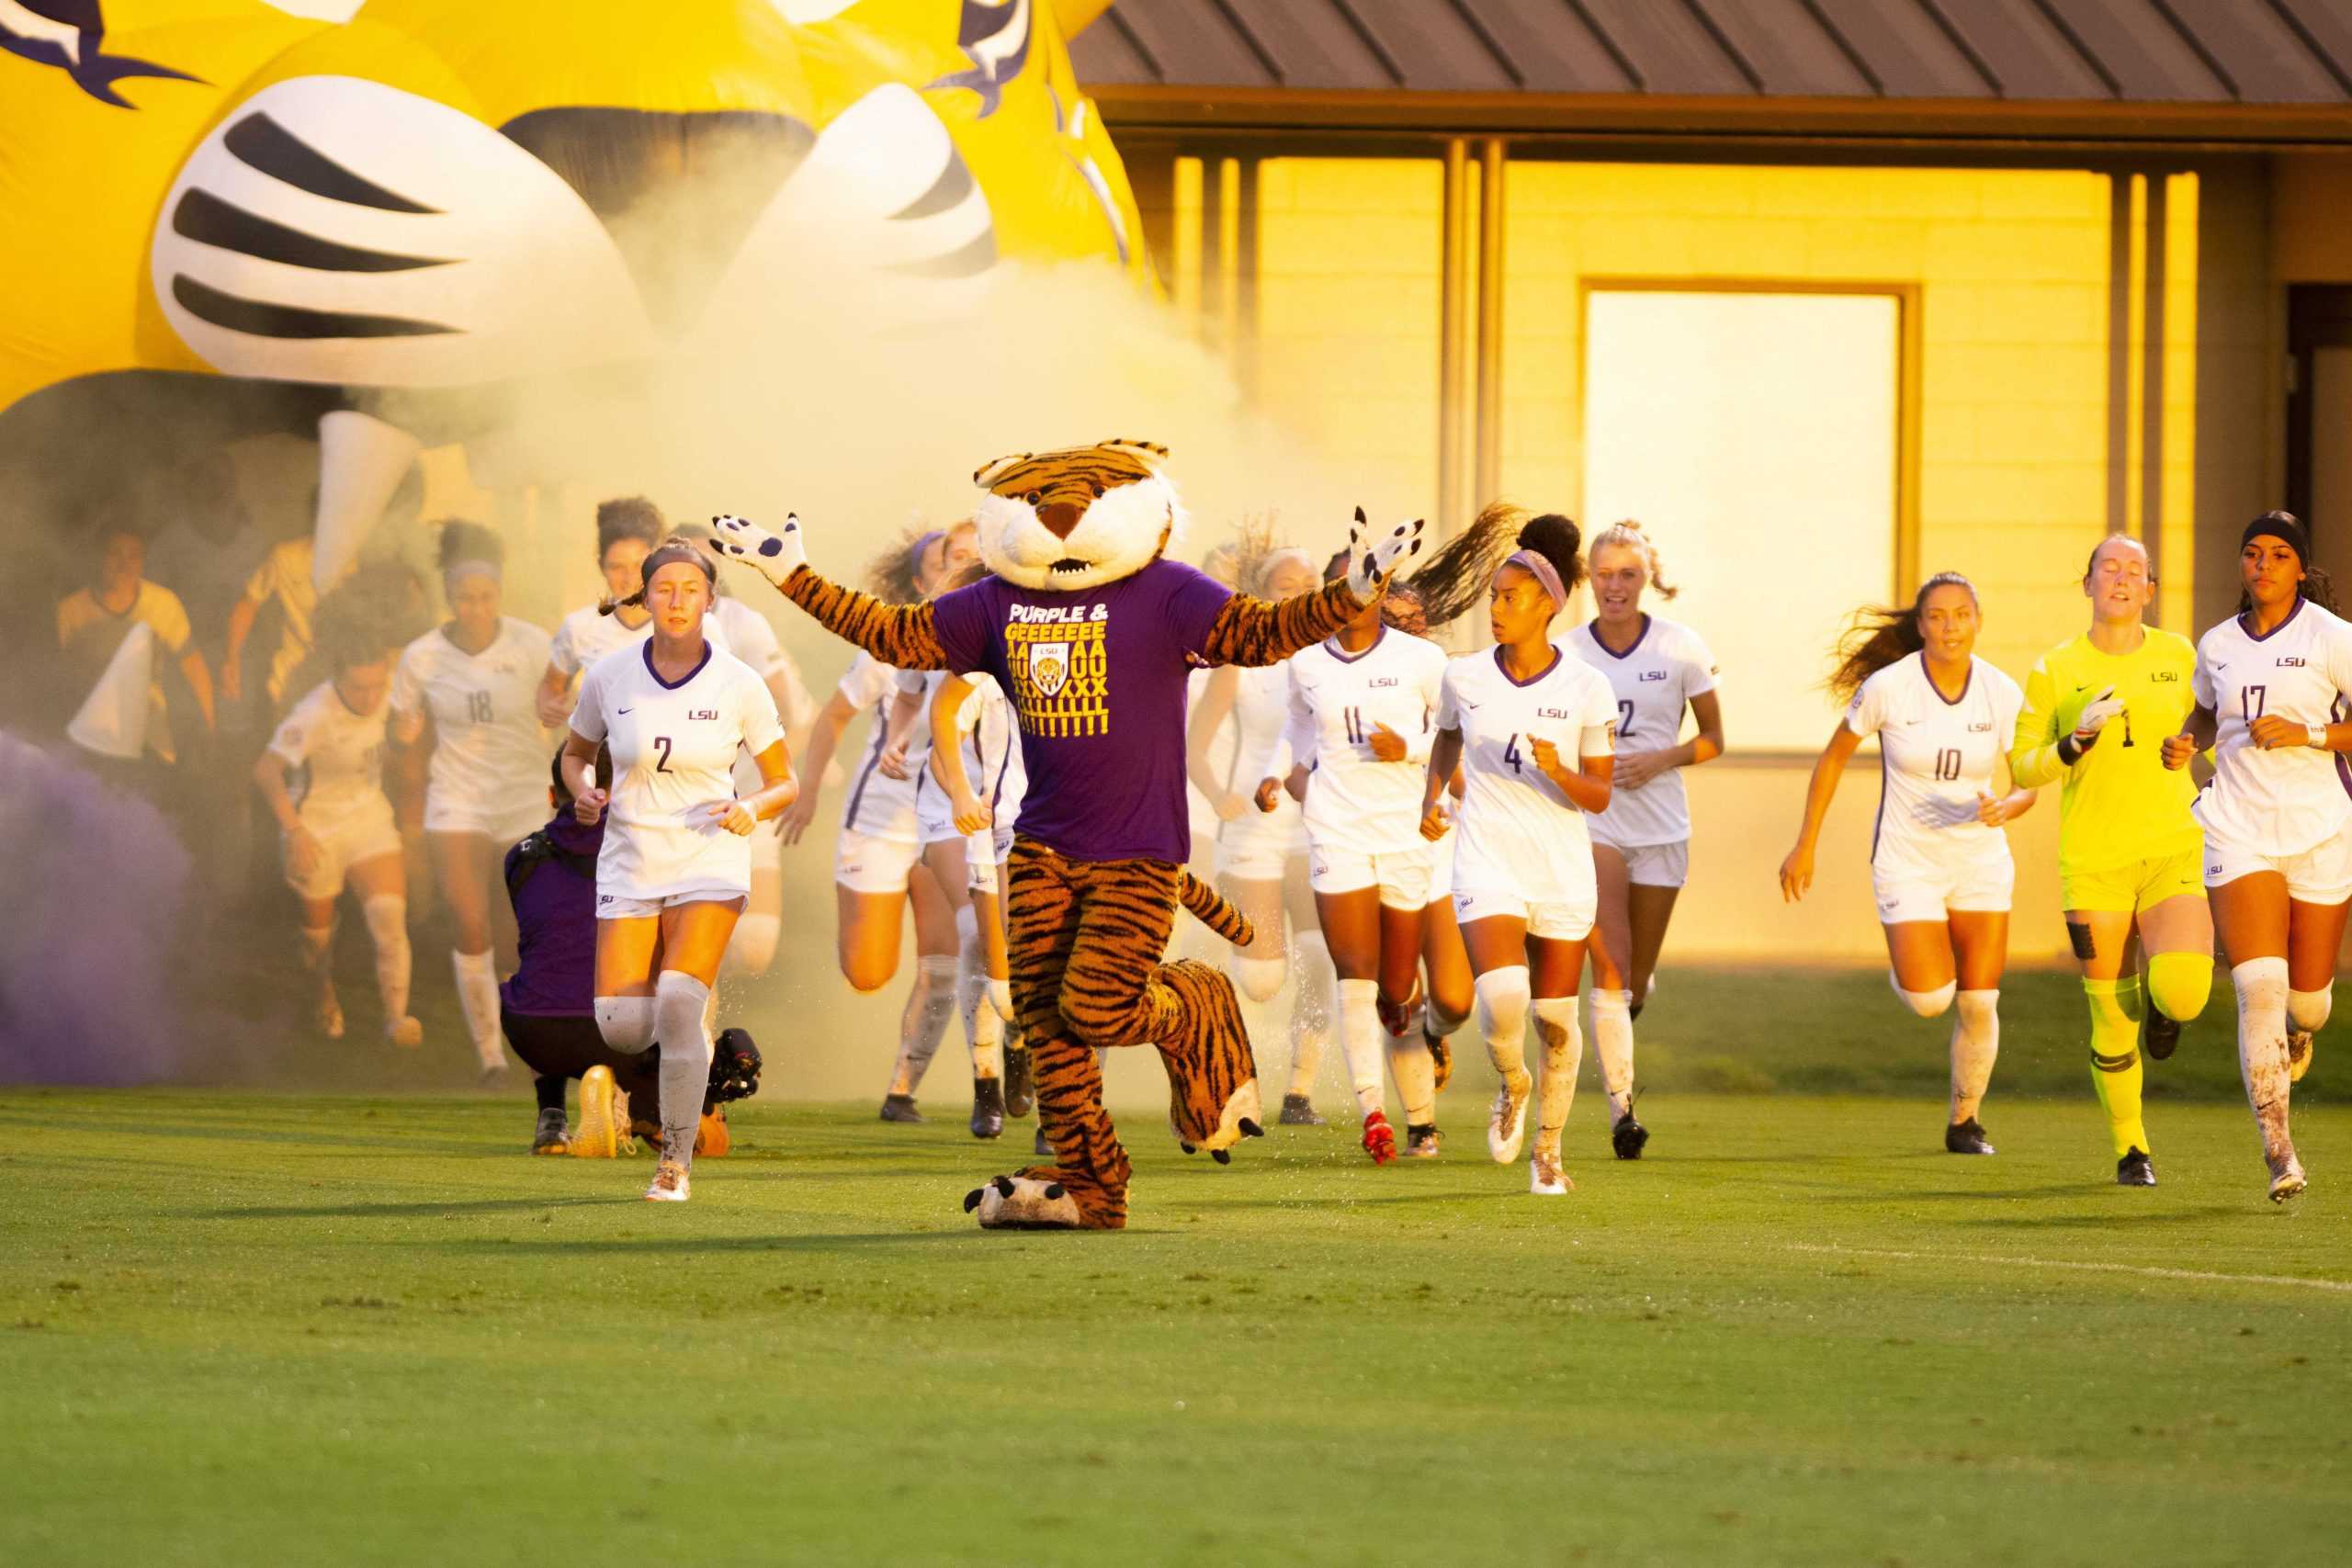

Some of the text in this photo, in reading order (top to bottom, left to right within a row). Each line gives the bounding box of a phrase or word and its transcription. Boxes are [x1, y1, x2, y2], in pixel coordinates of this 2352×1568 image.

[1009, 604, 1109, 623] PURPLE &
[1004, 621, 1107, 642] GEEEEEEE
[1070, 639, 1107, 660] AA
[1070, 658, 1107, 679] UU
[2276, 658, 2305, 667] LSU
[1369, 678, 1398, 688] LSU
[1639, 671, 1667, 682] LSU
[2152, 672, 2177, 682] LSU
[467, 691, 493, 723] 18
[688, 710, 718, 720] LSU
[1538, 707, 1567, 718] LSU
[2242, 685, 2266, 727] 17
[1344, 705, 1363, 743] 11
[1614, 699, 1636, 737] 2
[1968, 723, 1992, 732] LSU
[2121, 709, 2134, 748] 1
[653, 736, 673, 773] 2
[1505, 733, 1521, 773] 4
[1936, 748, 1962, 781] 10
[2207, 864, 2222, 875] LSU
